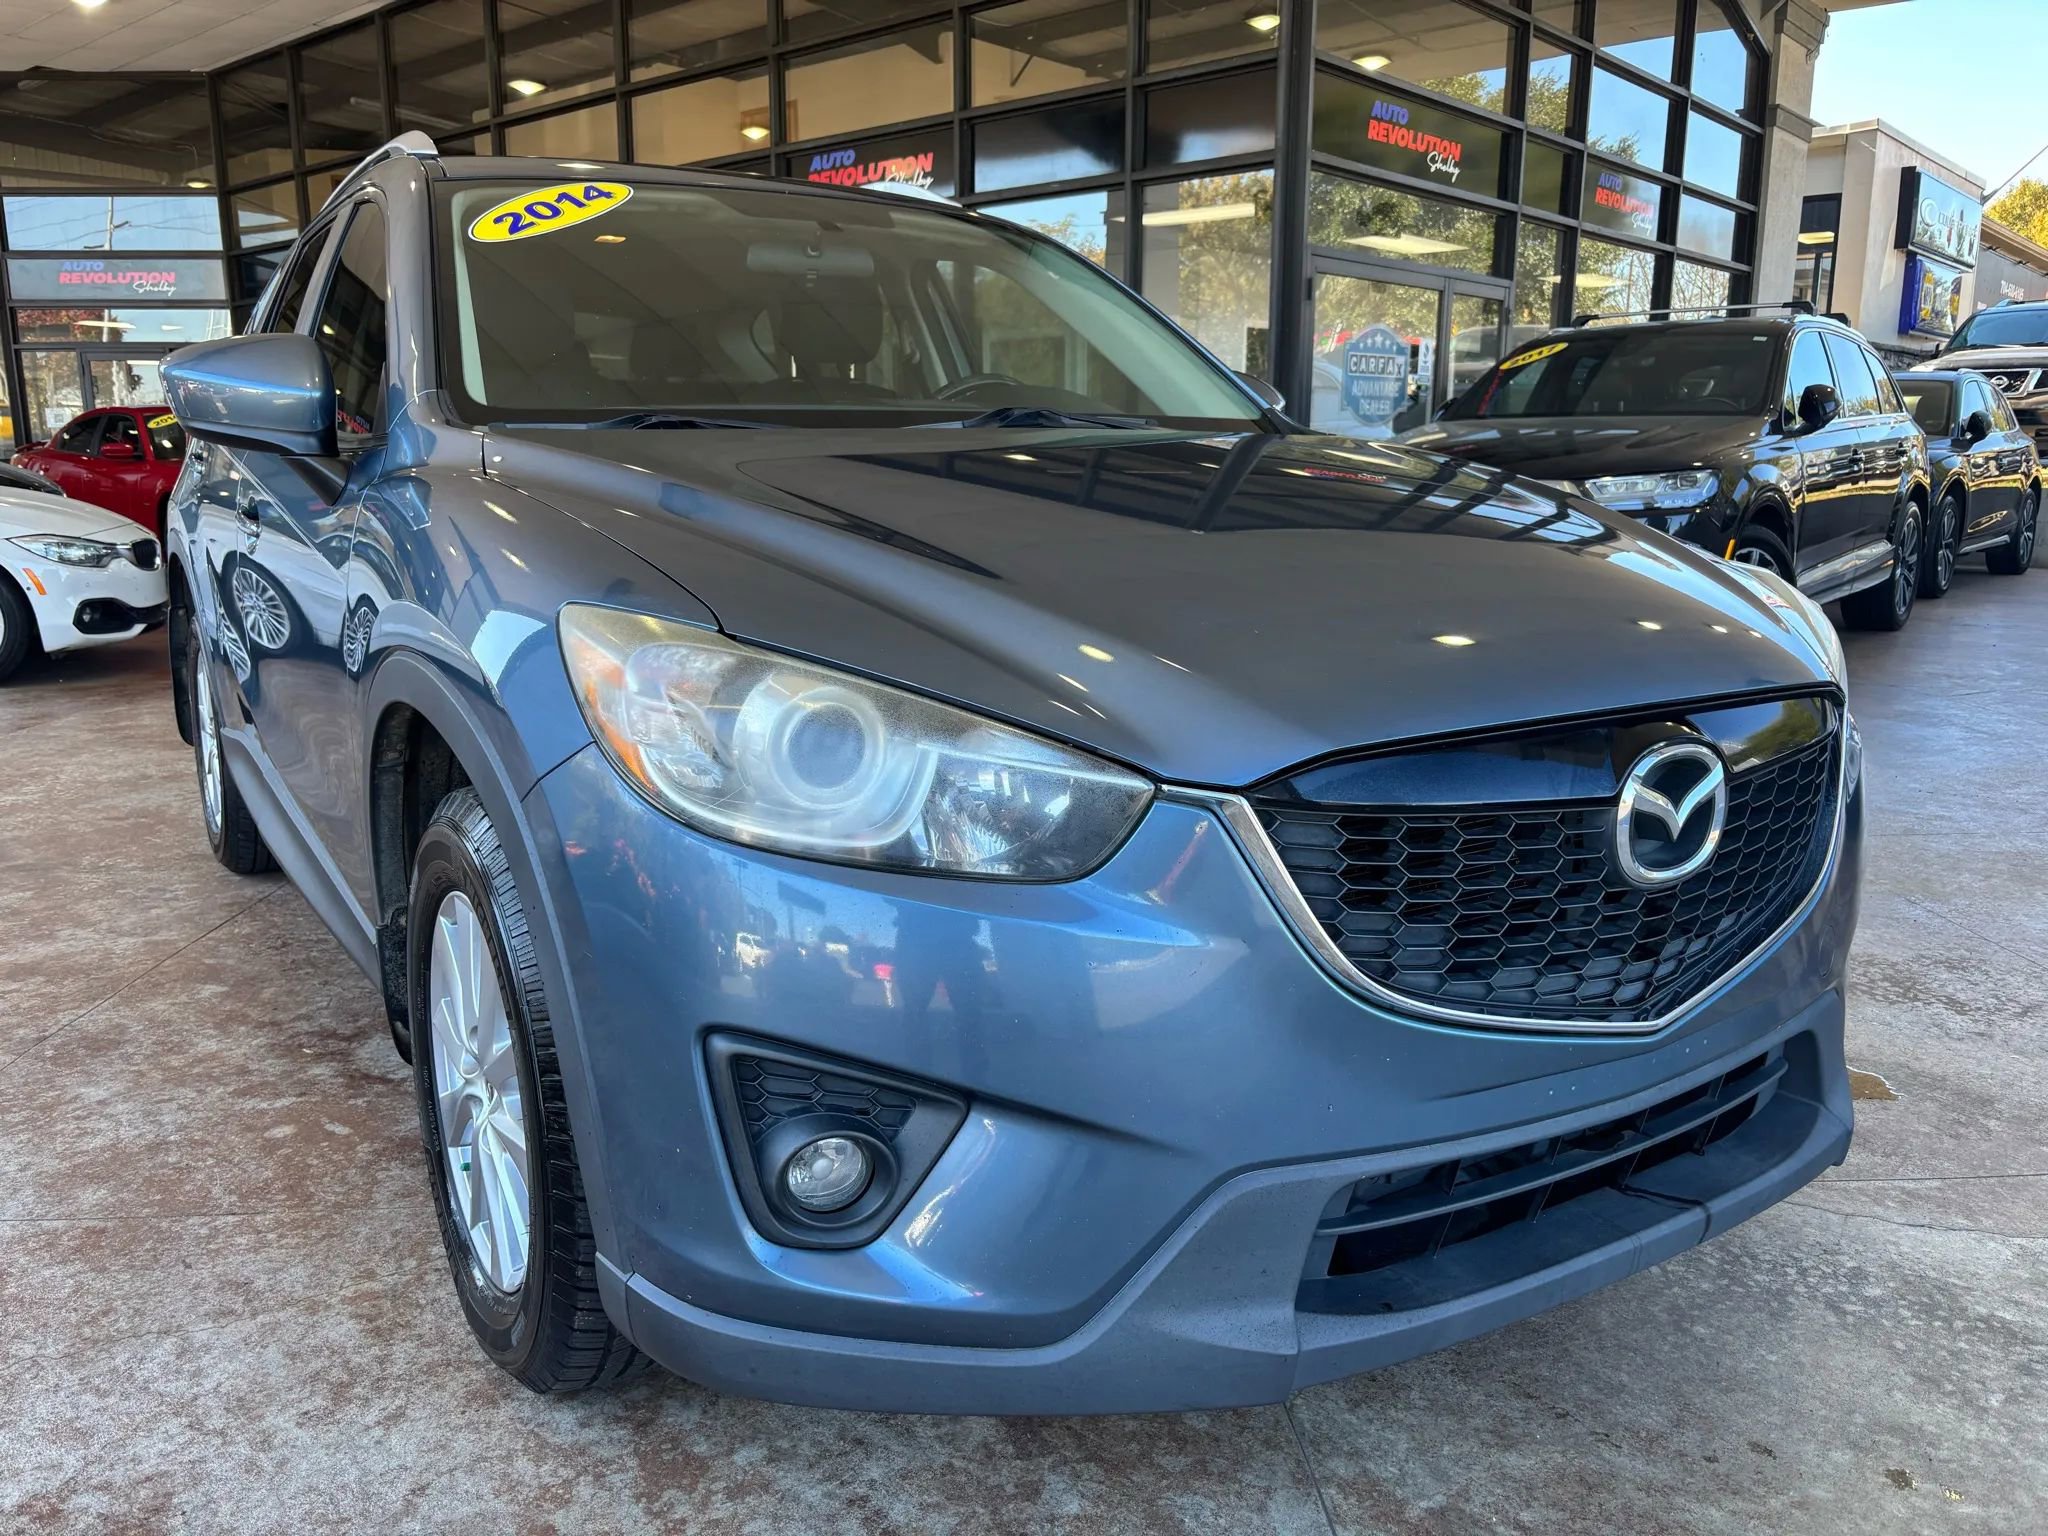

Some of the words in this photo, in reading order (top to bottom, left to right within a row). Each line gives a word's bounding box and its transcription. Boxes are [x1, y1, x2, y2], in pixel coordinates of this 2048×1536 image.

[1371, 100, 1409, 125] AUTO
[1367, 119, 1462, 161] REVOLUTION
[810, 149, 856, 173] AUTO
[1426, 151, 1461, 183] Shelby
[1599, 172, 1623, 192] AUTO
[492, 184, 616, 236] 2014
[1595, 186, 1655, 219] REVOLUTION
[58, 271, 176, 284] REVOLUTION
[61, 261, 105, 272] AUTO
[132, 279, 177, 297] Shelby
[1349, 354, 1404, 378] CARFAX
[1358, 399, 1391, 415] DEALER
